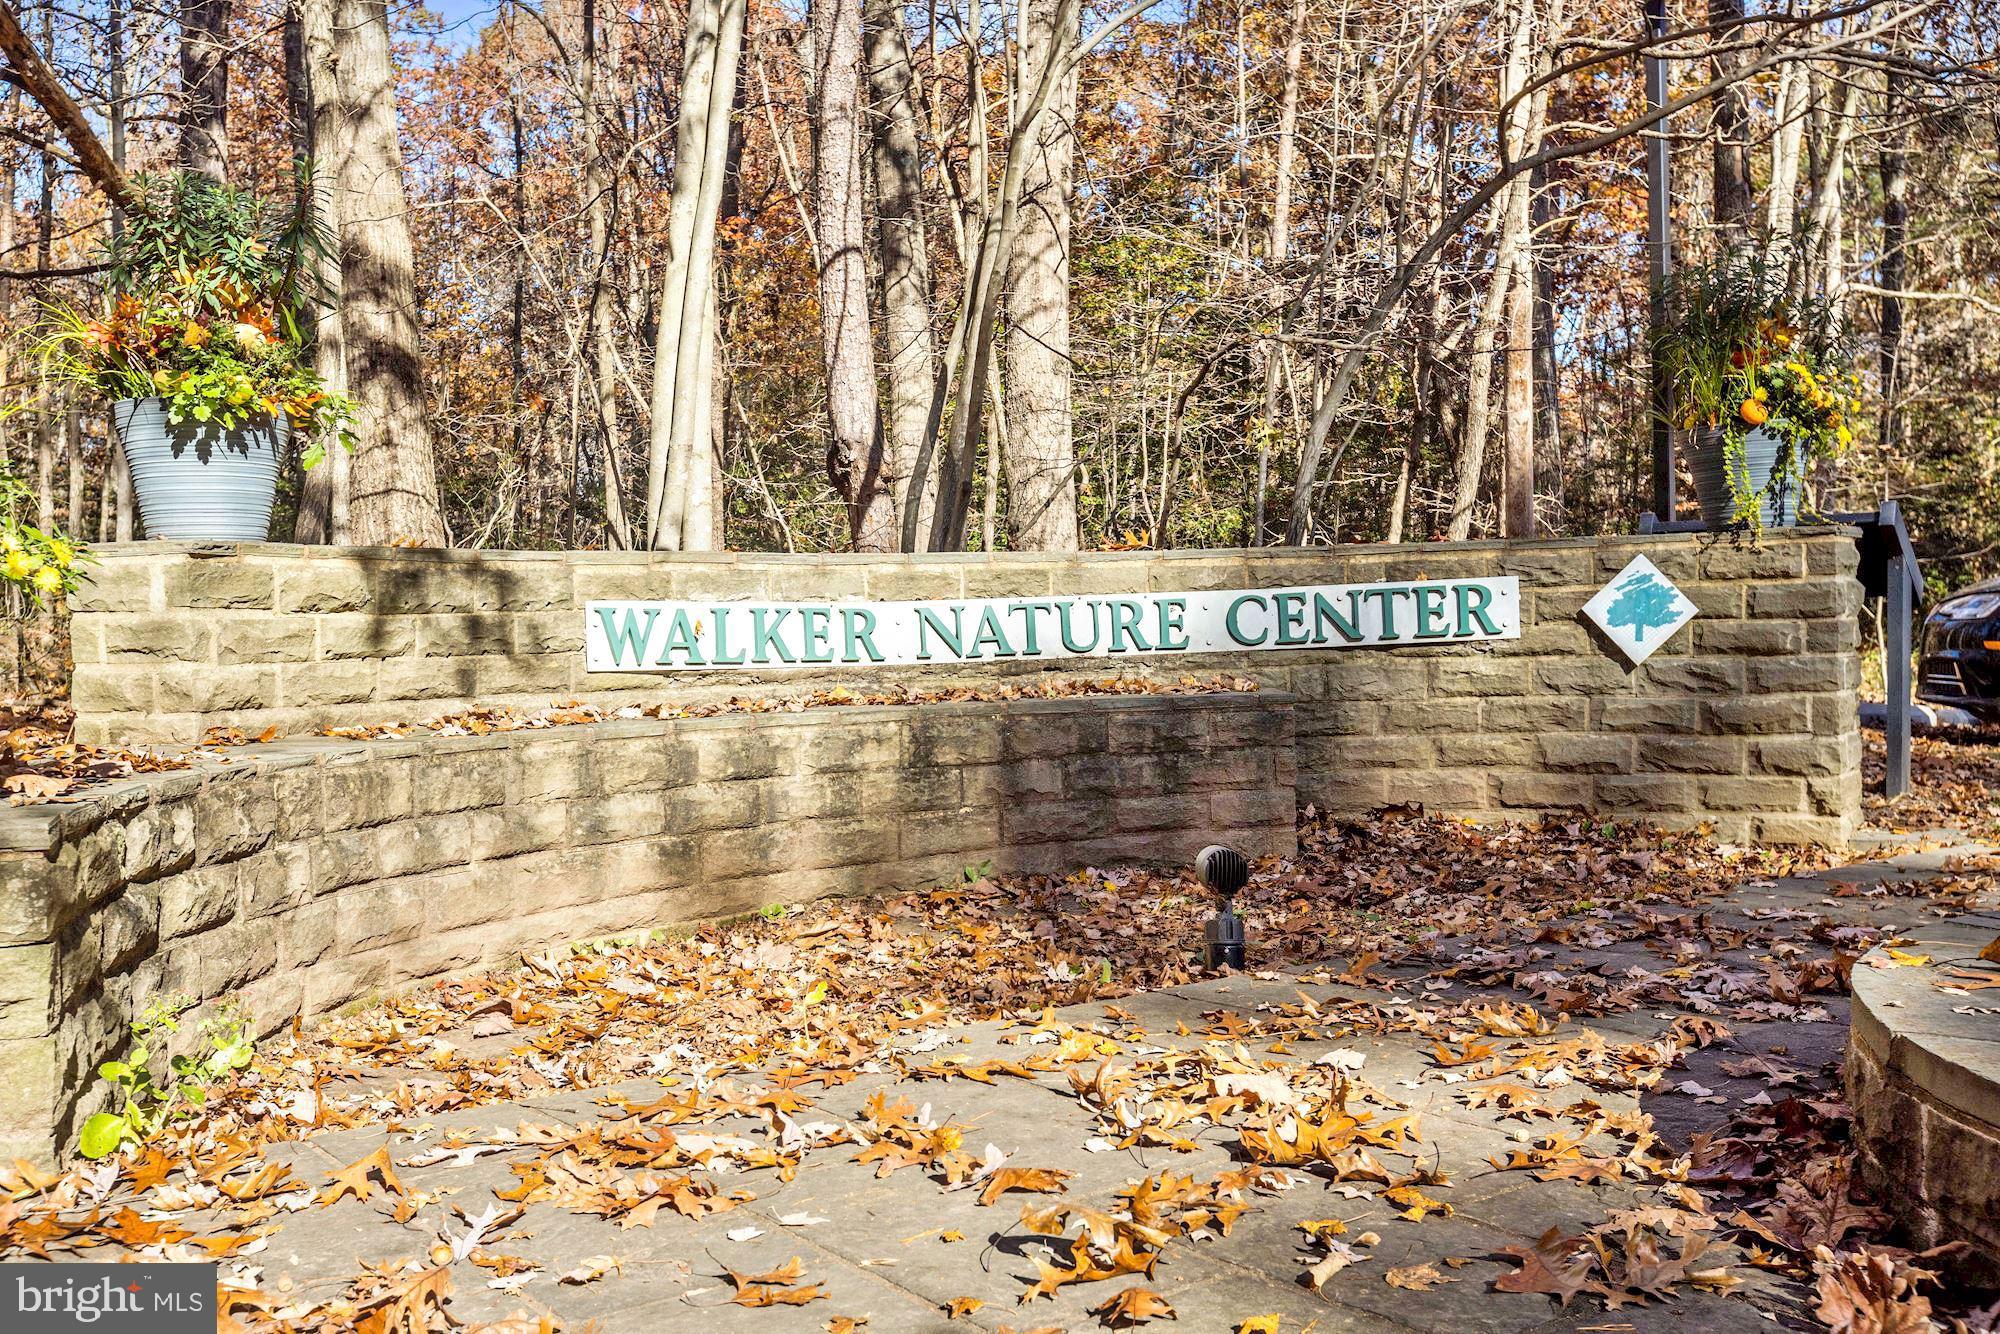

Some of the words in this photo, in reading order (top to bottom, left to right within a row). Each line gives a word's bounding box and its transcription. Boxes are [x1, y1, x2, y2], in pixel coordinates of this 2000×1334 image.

[593, 606, 886, 667] WALKER
[914, 596, 1190, 660] NATURE
[1226, 584, 1504, 646] CENTER
